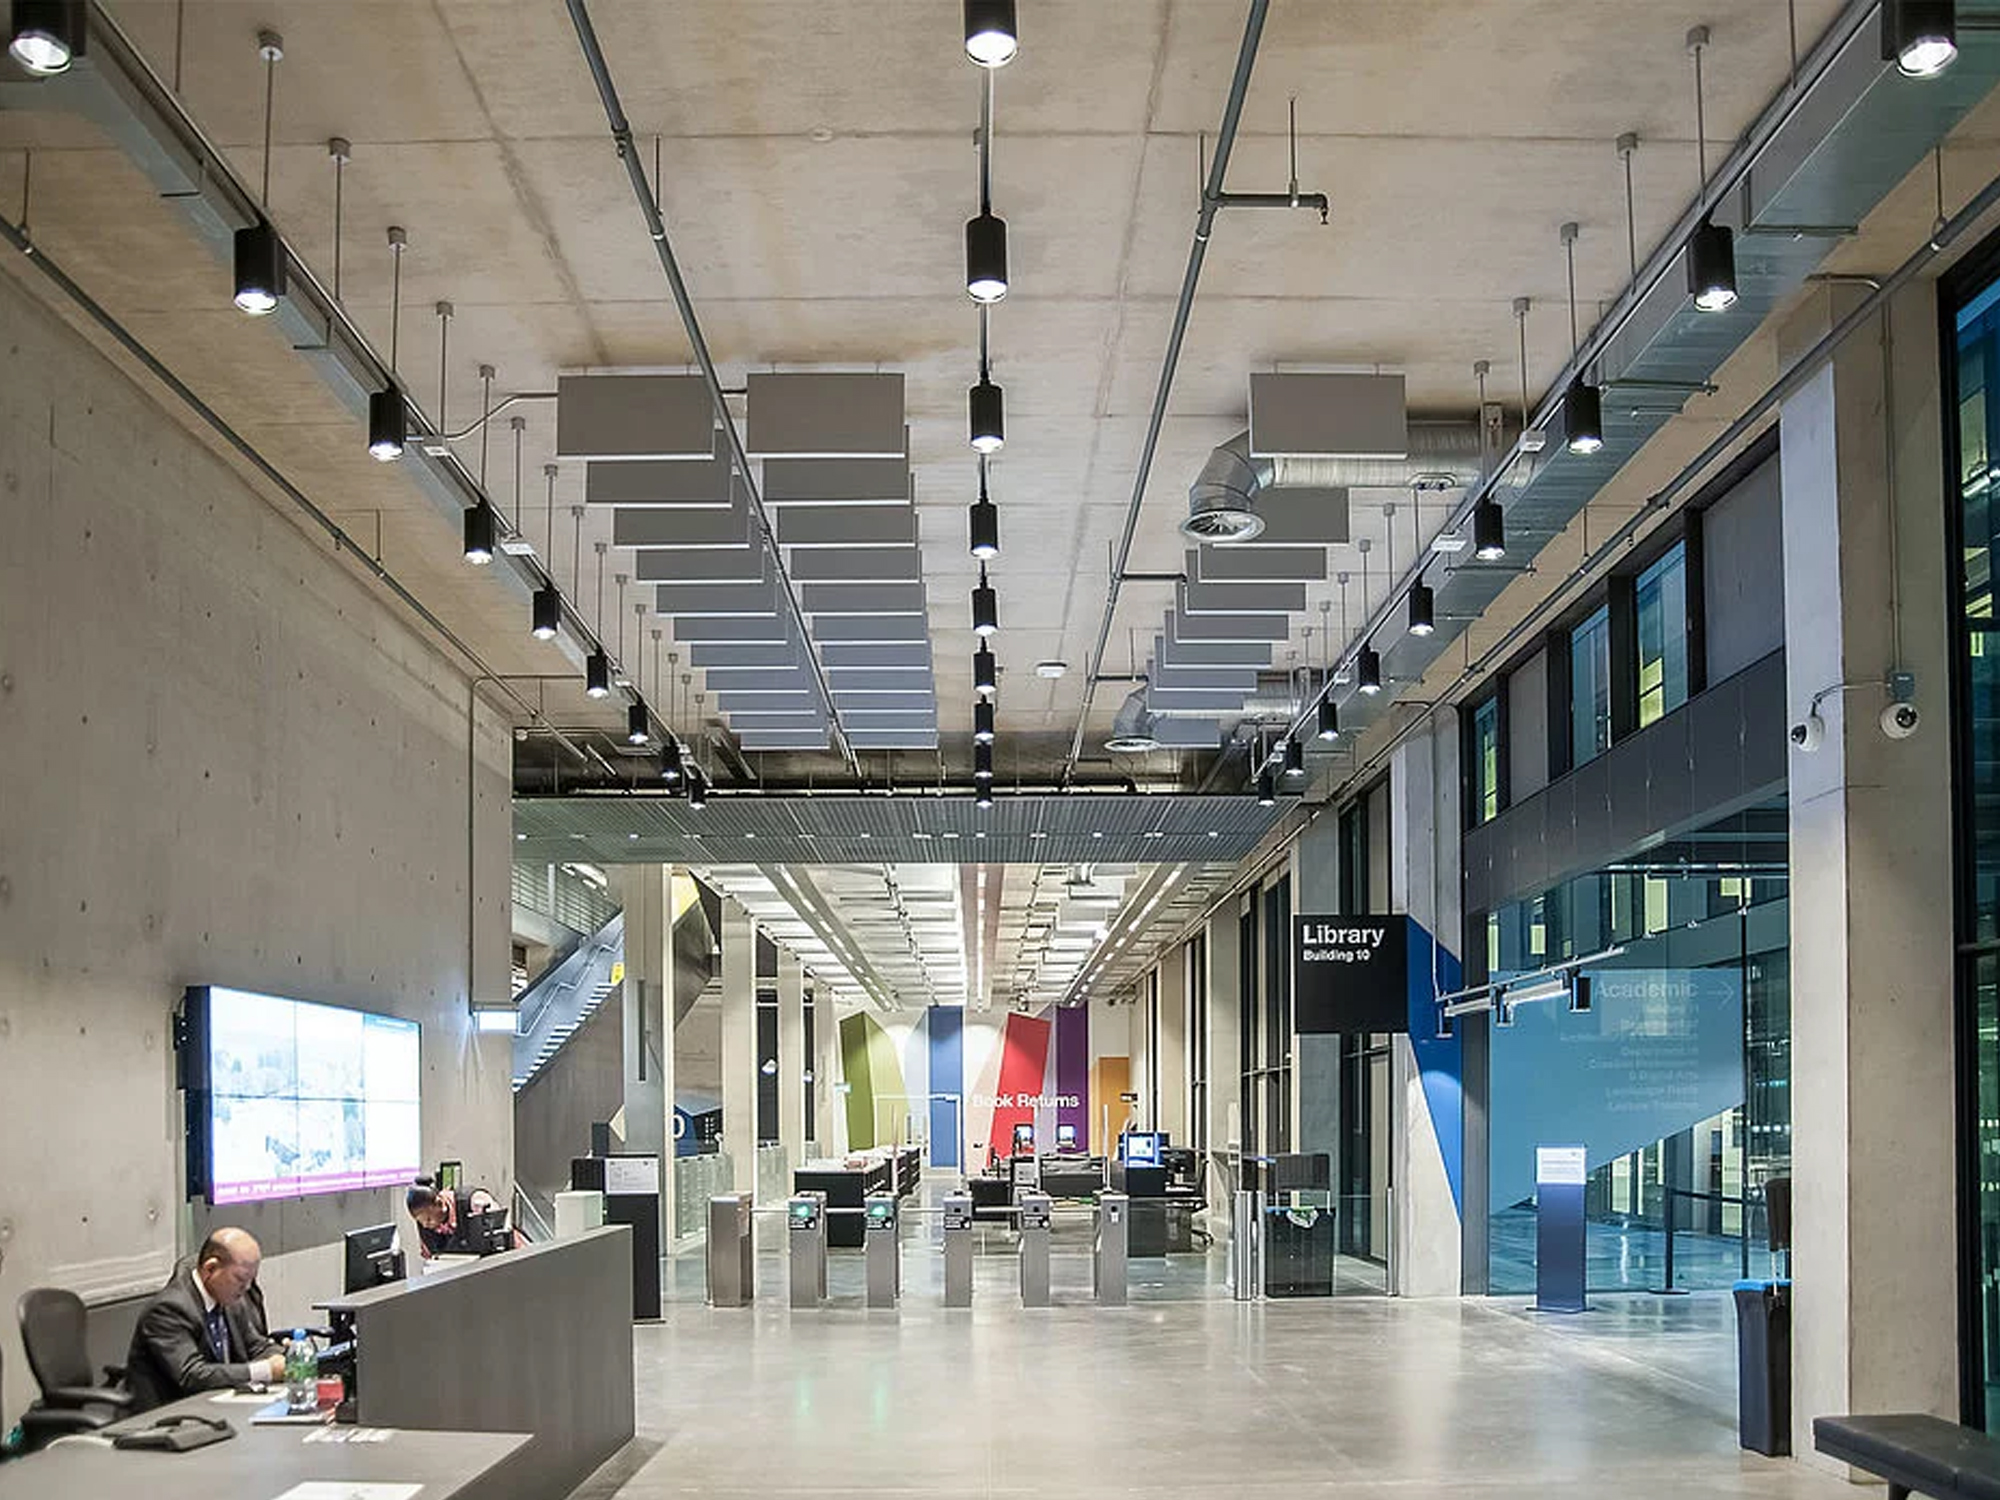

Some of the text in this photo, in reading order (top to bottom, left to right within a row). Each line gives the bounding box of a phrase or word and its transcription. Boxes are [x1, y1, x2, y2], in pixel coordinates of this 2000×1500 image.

[1303, 925, 1385, 948] Library
[1303, 949, 1371, 963] Building 10
[1595, 977, 1699, 998] Academic
[973, 1093, 1080, 1108] Book Returns
